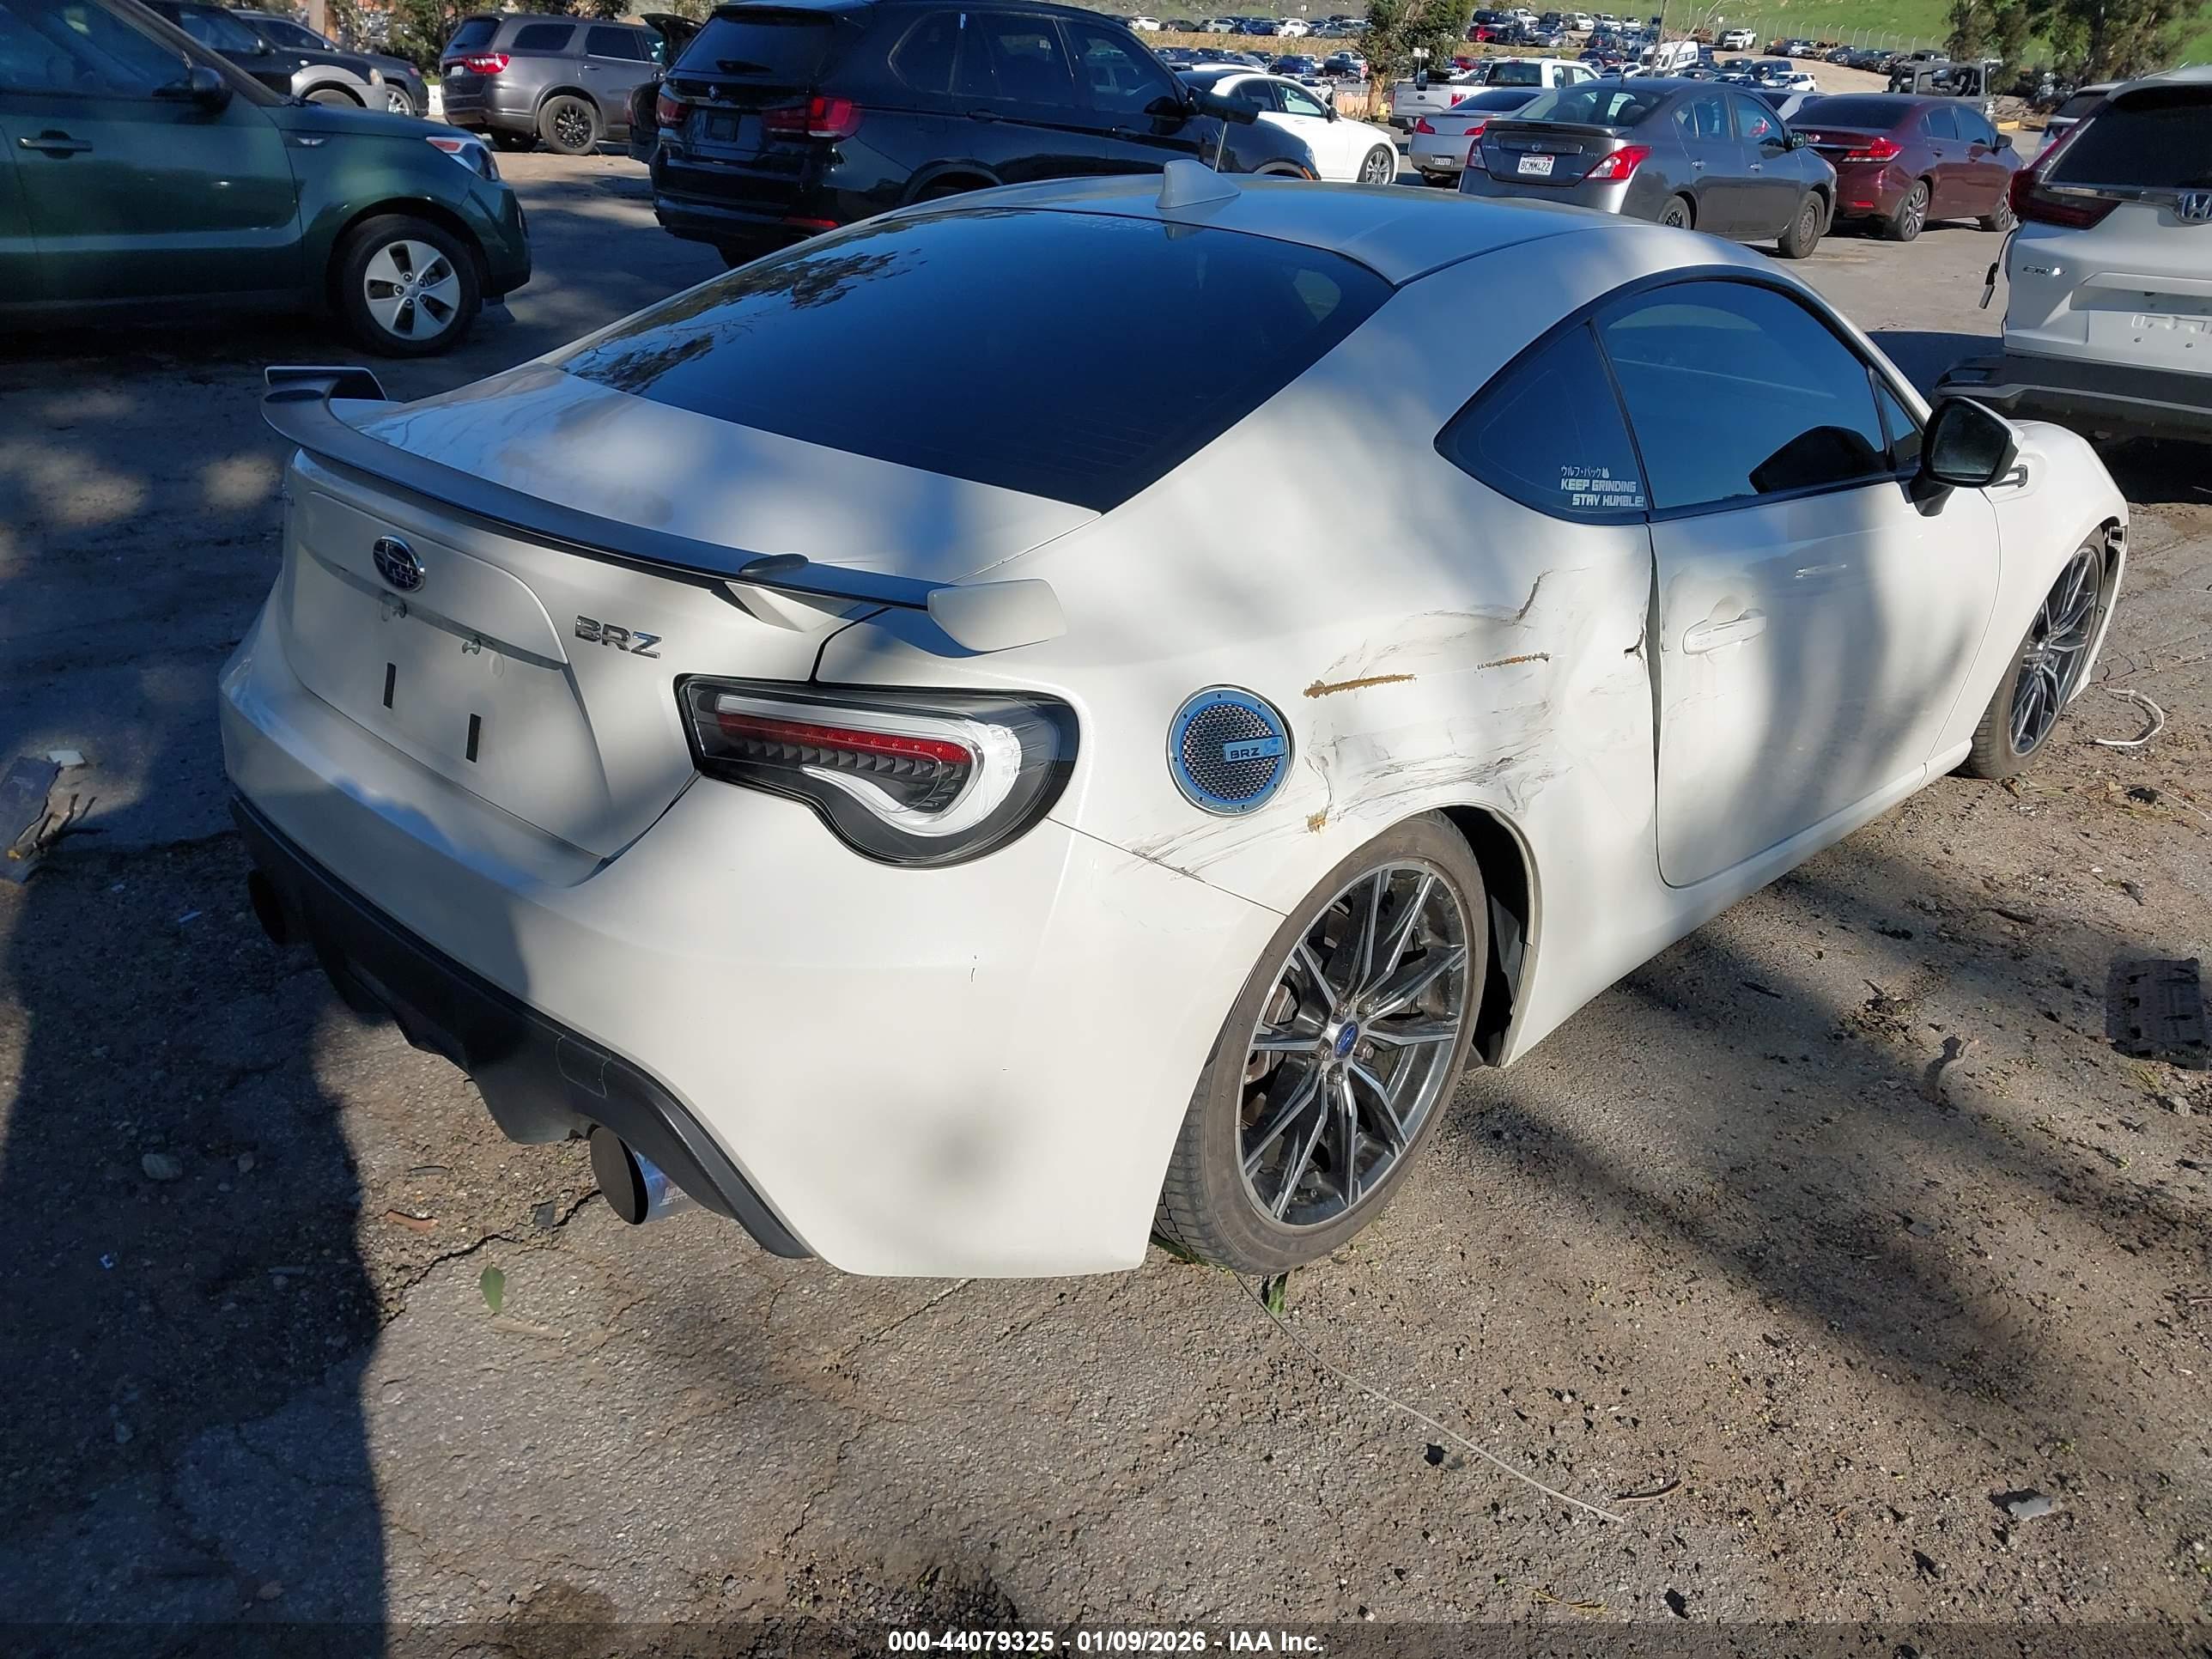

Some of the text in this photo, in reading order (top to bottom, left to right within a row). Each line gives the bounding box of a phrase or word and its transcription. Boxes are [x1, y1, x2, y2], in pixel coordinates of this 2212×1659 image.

[1560, 478, 1637, 492] KEEP GRINDING
[1571, 494, 1644, 507] STAY HUMBLE!
[574, 614, 662, 659] BRZ
[1230, 747, 1260, 759] BRZ
